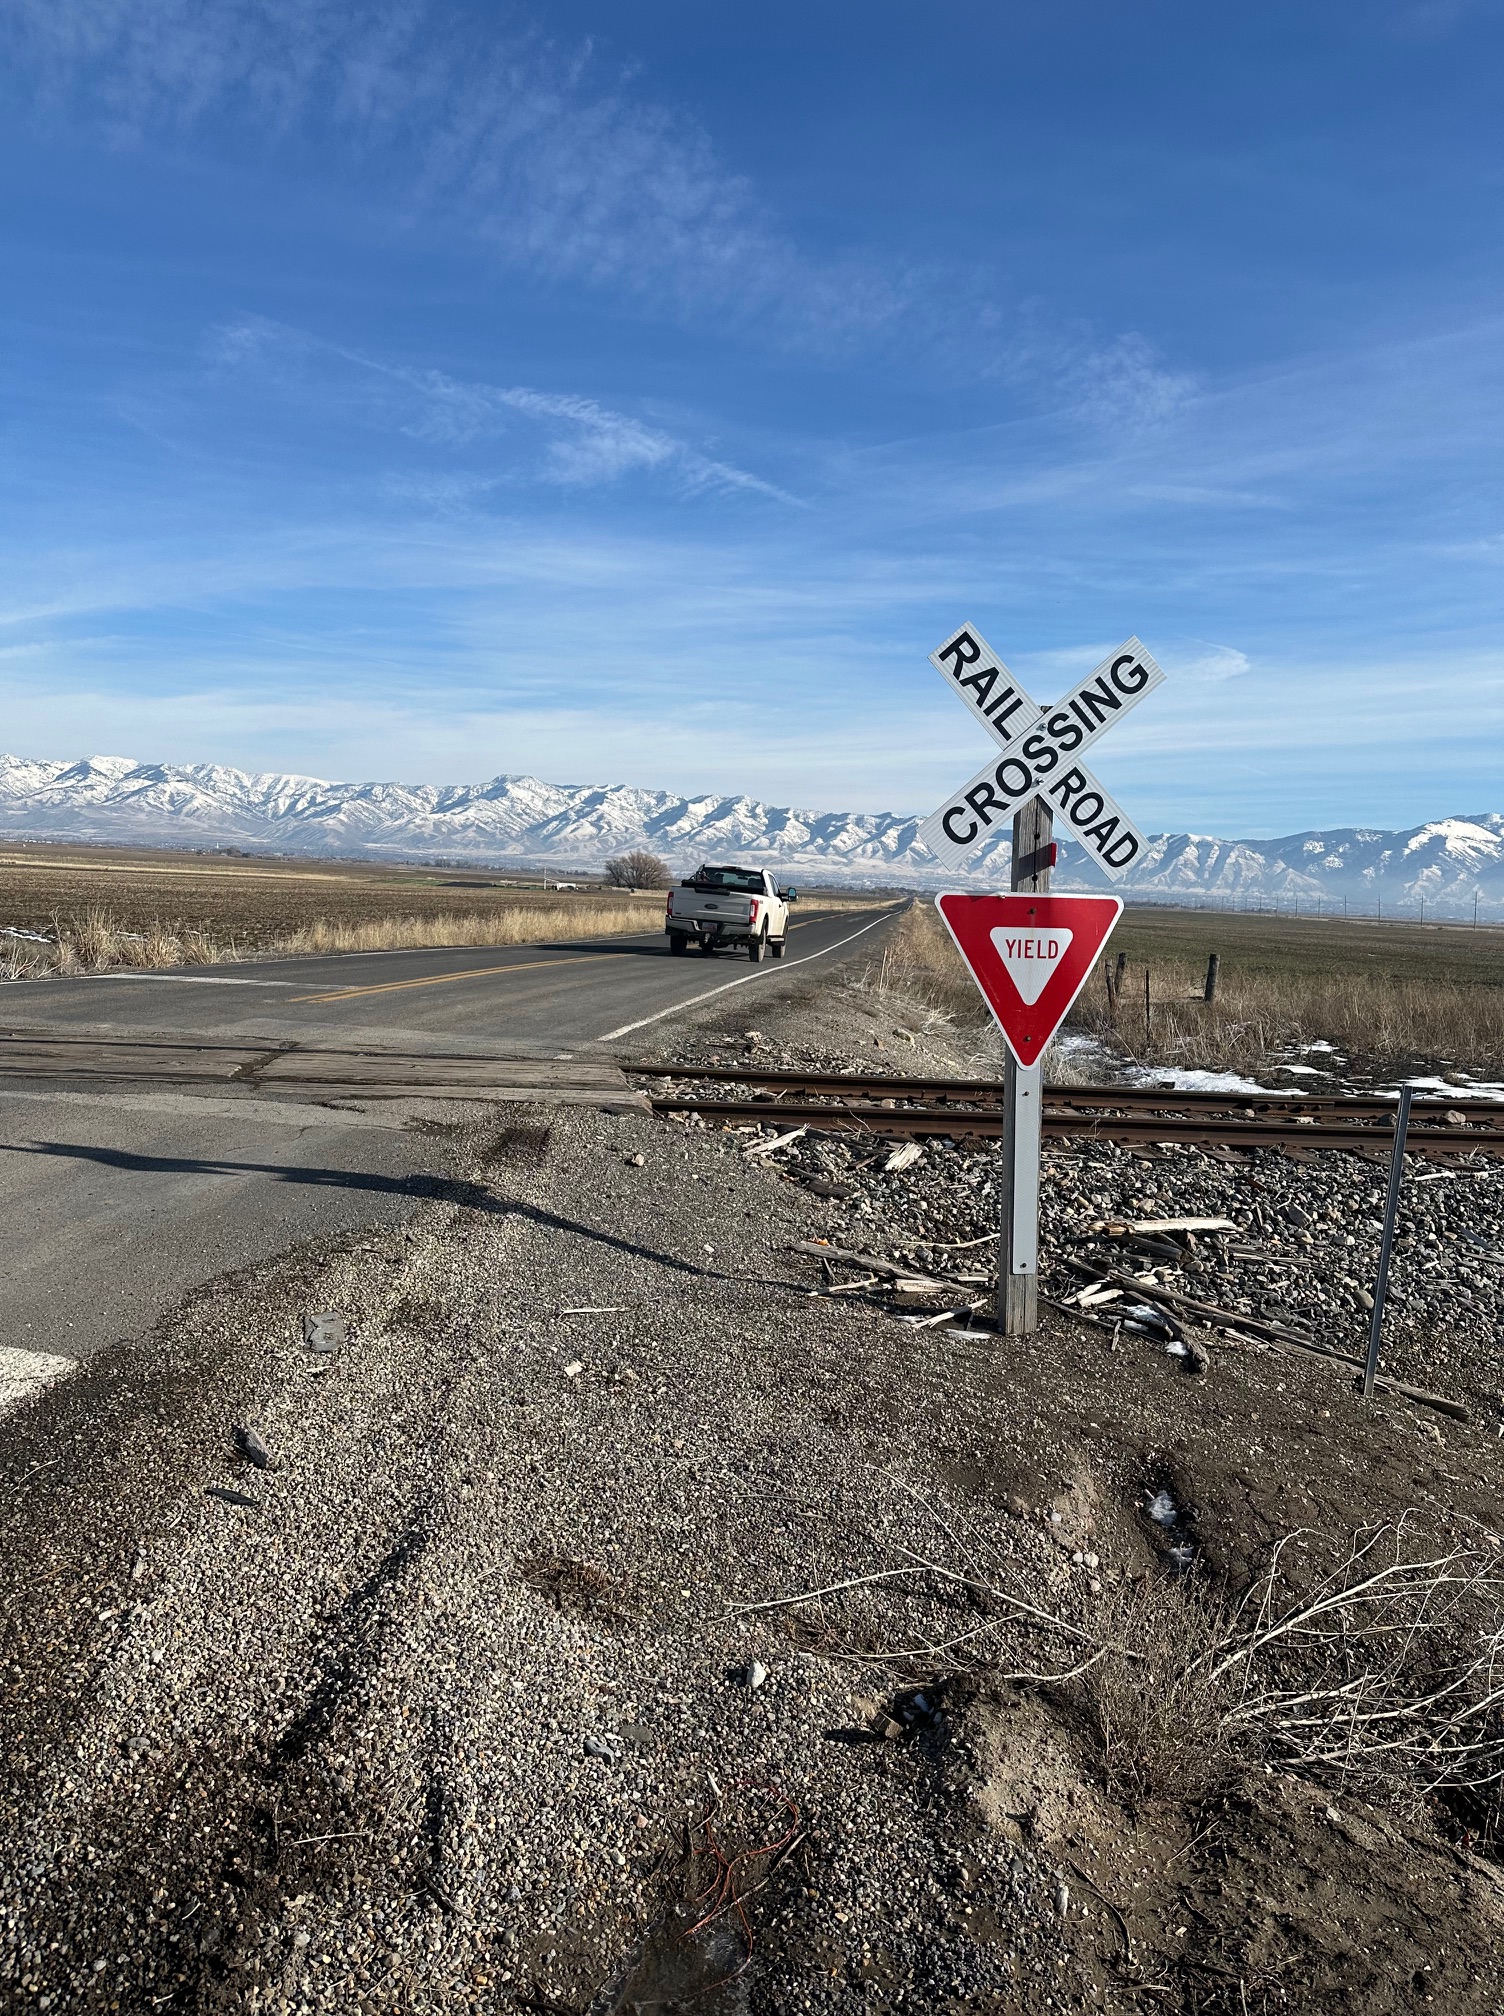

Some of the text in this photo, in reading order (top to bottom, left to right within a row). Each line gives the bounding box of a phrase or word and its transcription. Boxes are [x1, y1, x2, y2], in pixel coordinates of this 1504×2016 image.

[938, 631, 1139, 868] RAIL ROAD
[942, 654, 1149, 845] CROSSING
[1005, 939, 1059, 959] YIELD
